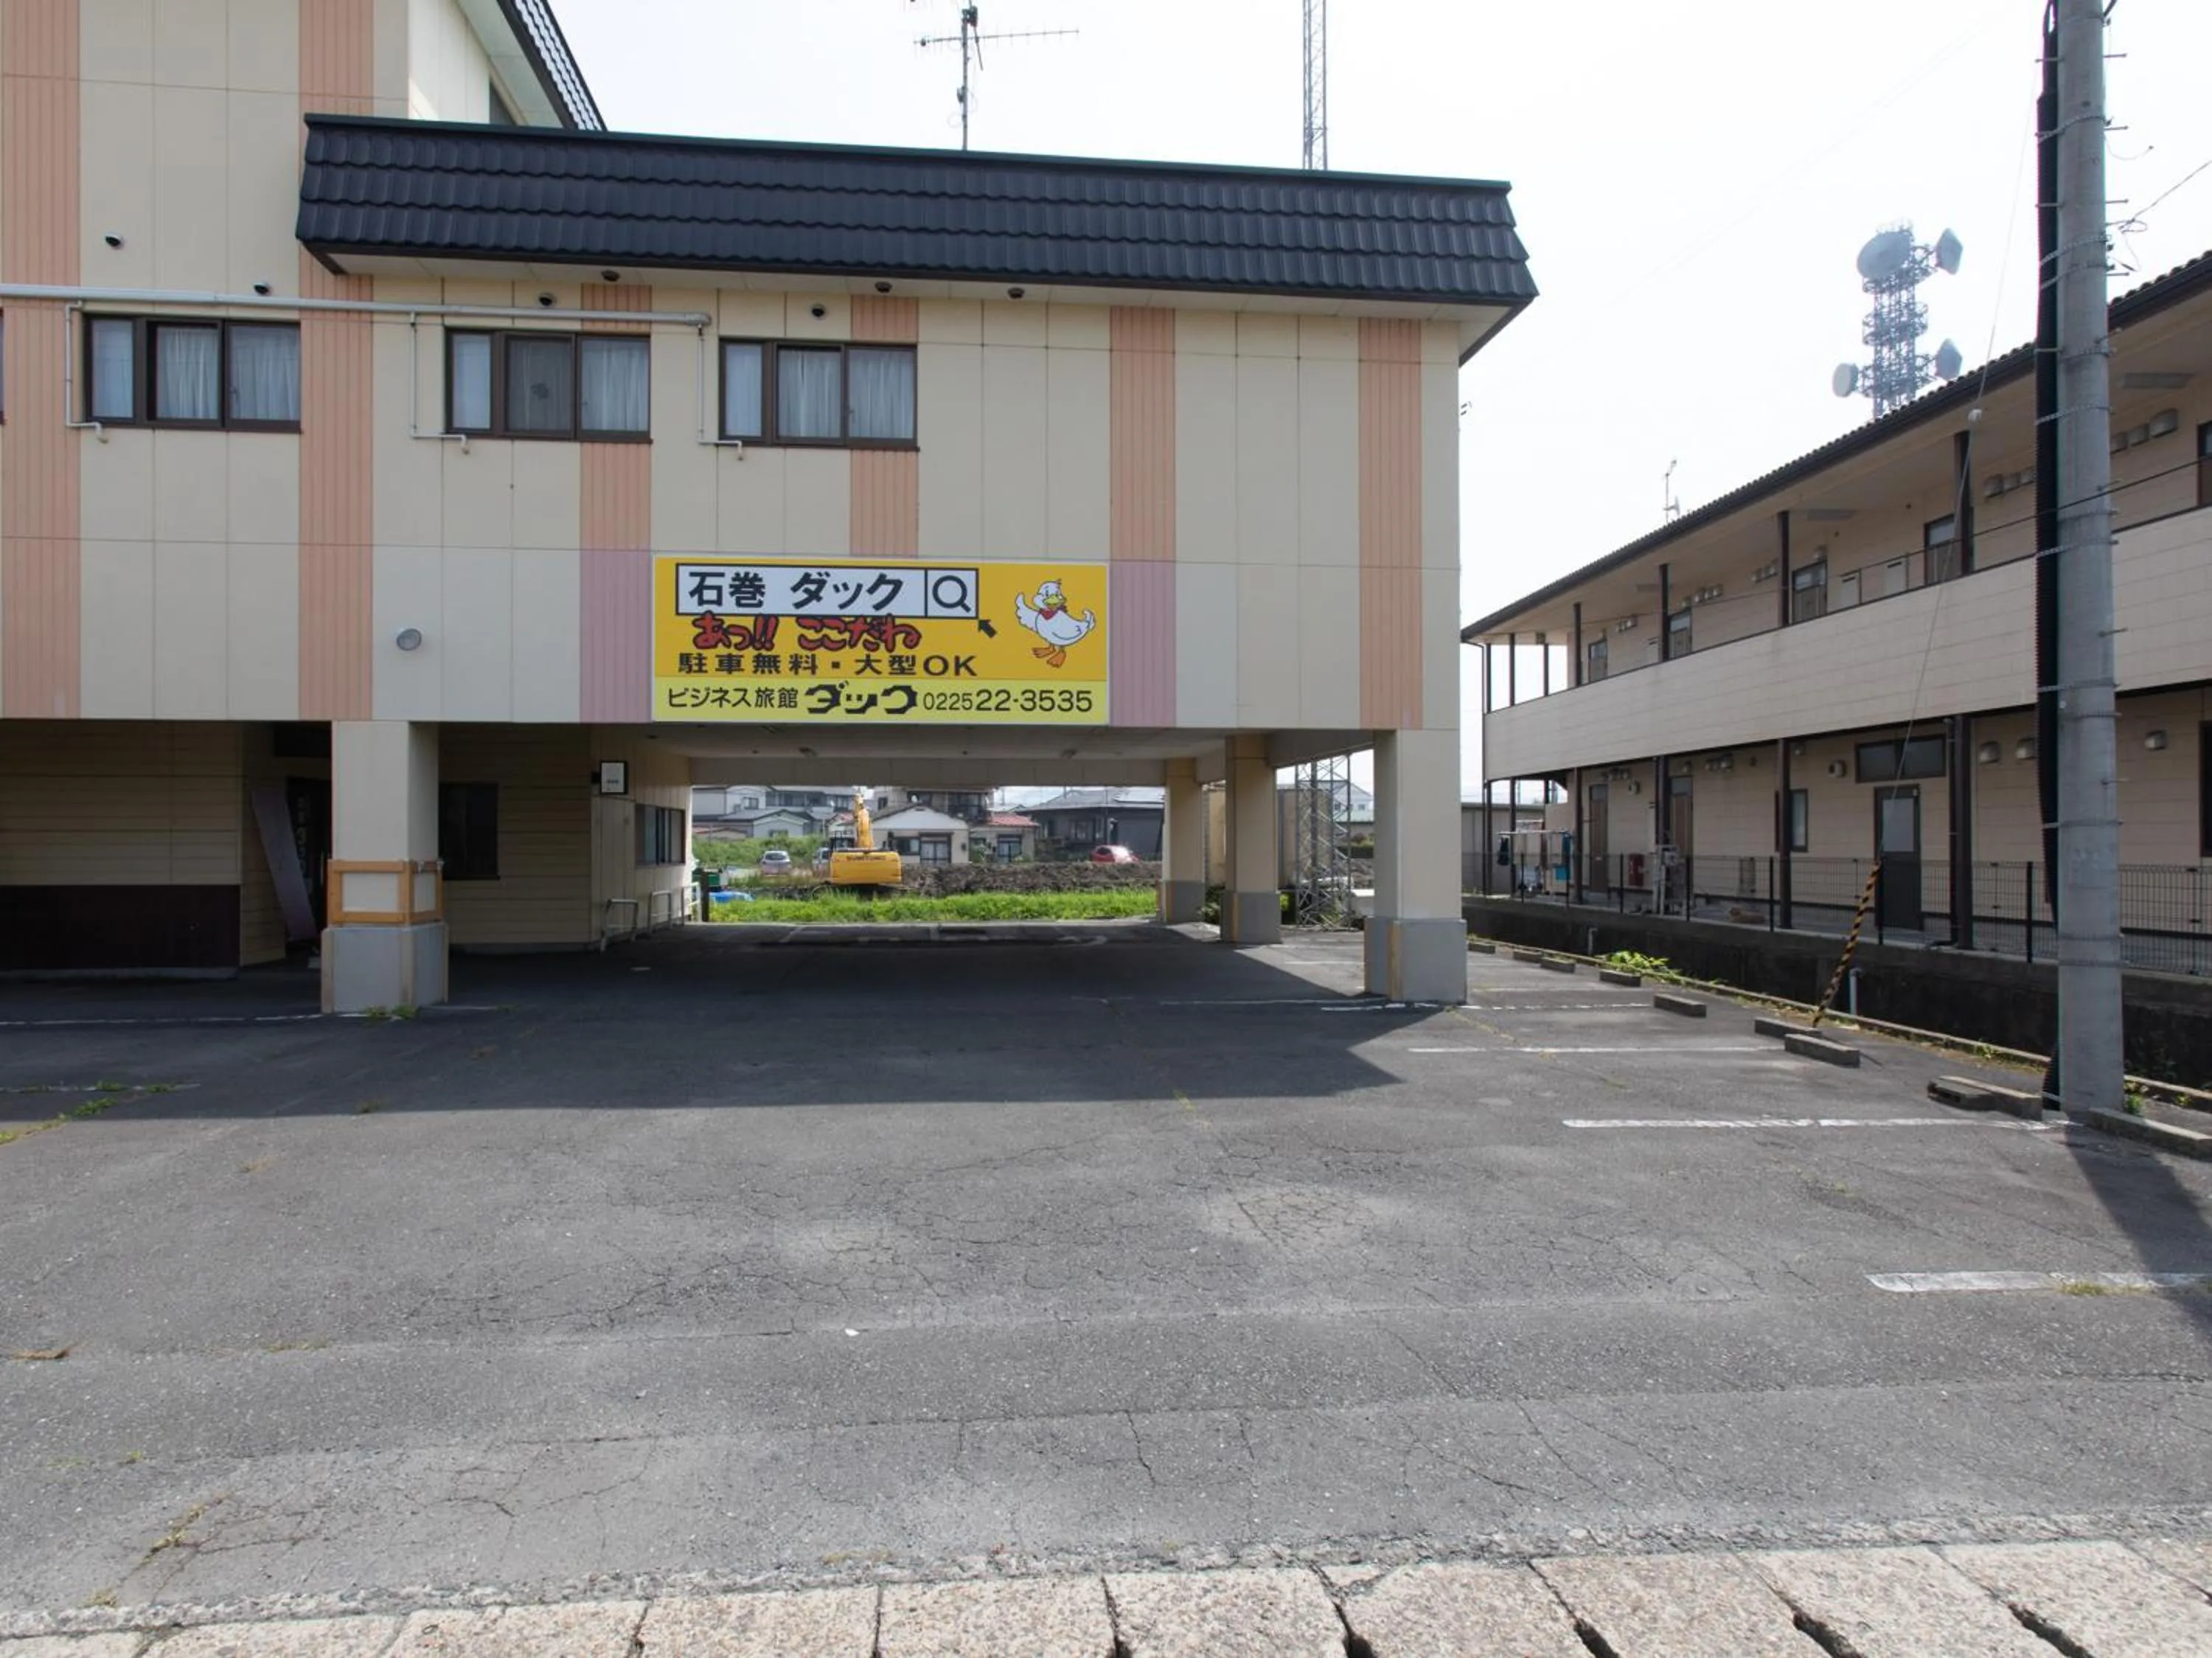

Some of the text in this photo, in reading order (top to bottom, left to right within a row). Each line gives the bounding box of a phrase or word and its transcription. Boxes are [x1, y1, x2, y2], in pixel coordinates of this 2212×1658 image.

[689, 571, 903, 611] 石巻 ダック
[796, 613, 922, 653] ここだね
[668, 687, 799, 709] ビジネス旅館
